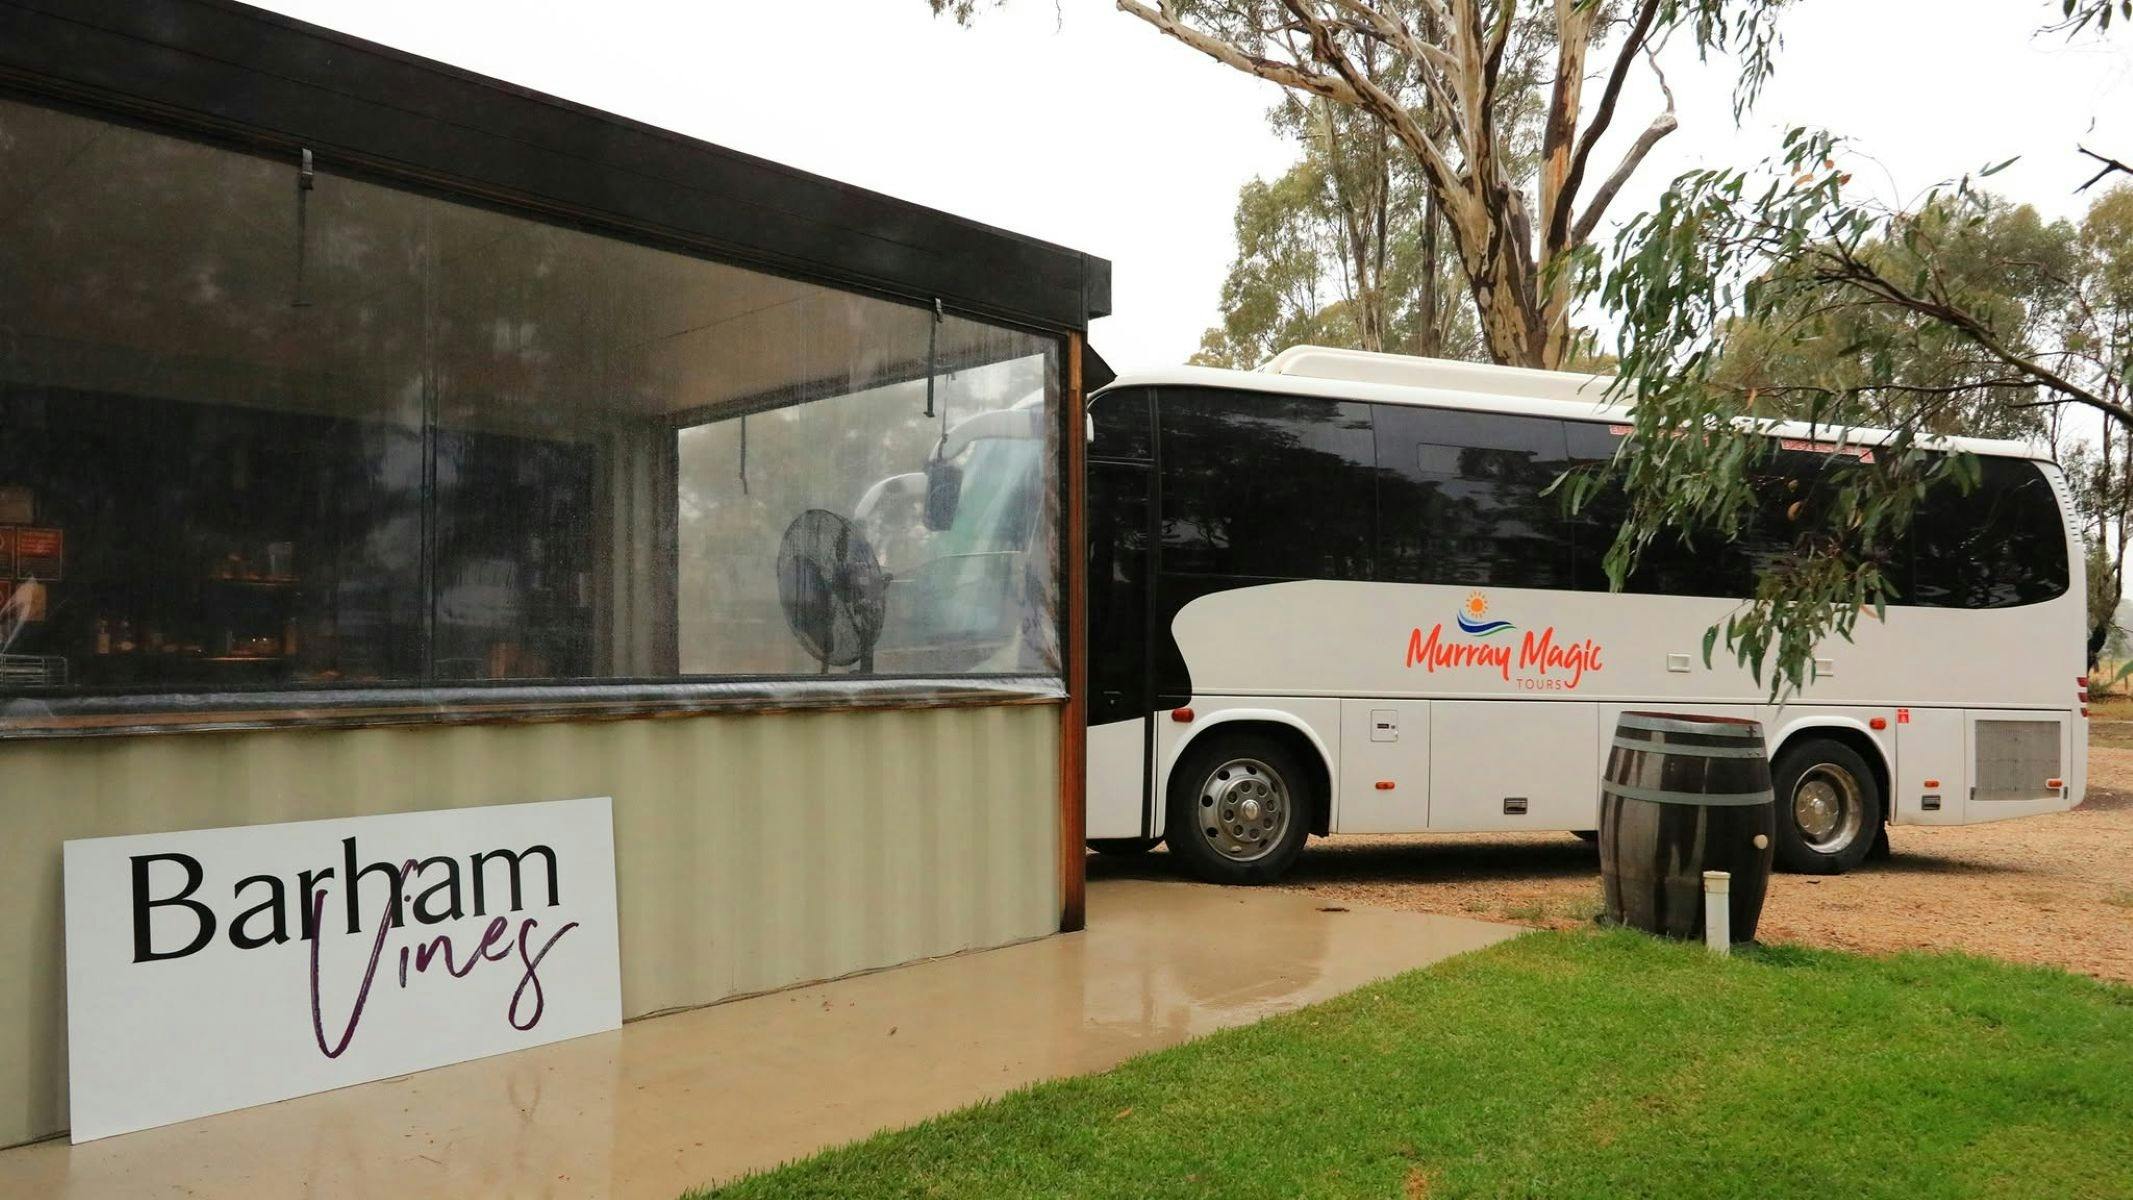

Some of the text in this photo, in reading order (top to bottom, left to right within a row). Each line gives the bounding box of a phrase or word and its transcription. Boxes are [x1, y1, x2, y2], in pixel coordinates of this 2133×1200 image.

[1406, 623, 1603, 689] Murray Magic
[1516, 678, 1562, 690] TOURS
[129, 836, 561, 963] Barham
[311, 859, 579, 1059] Vines
